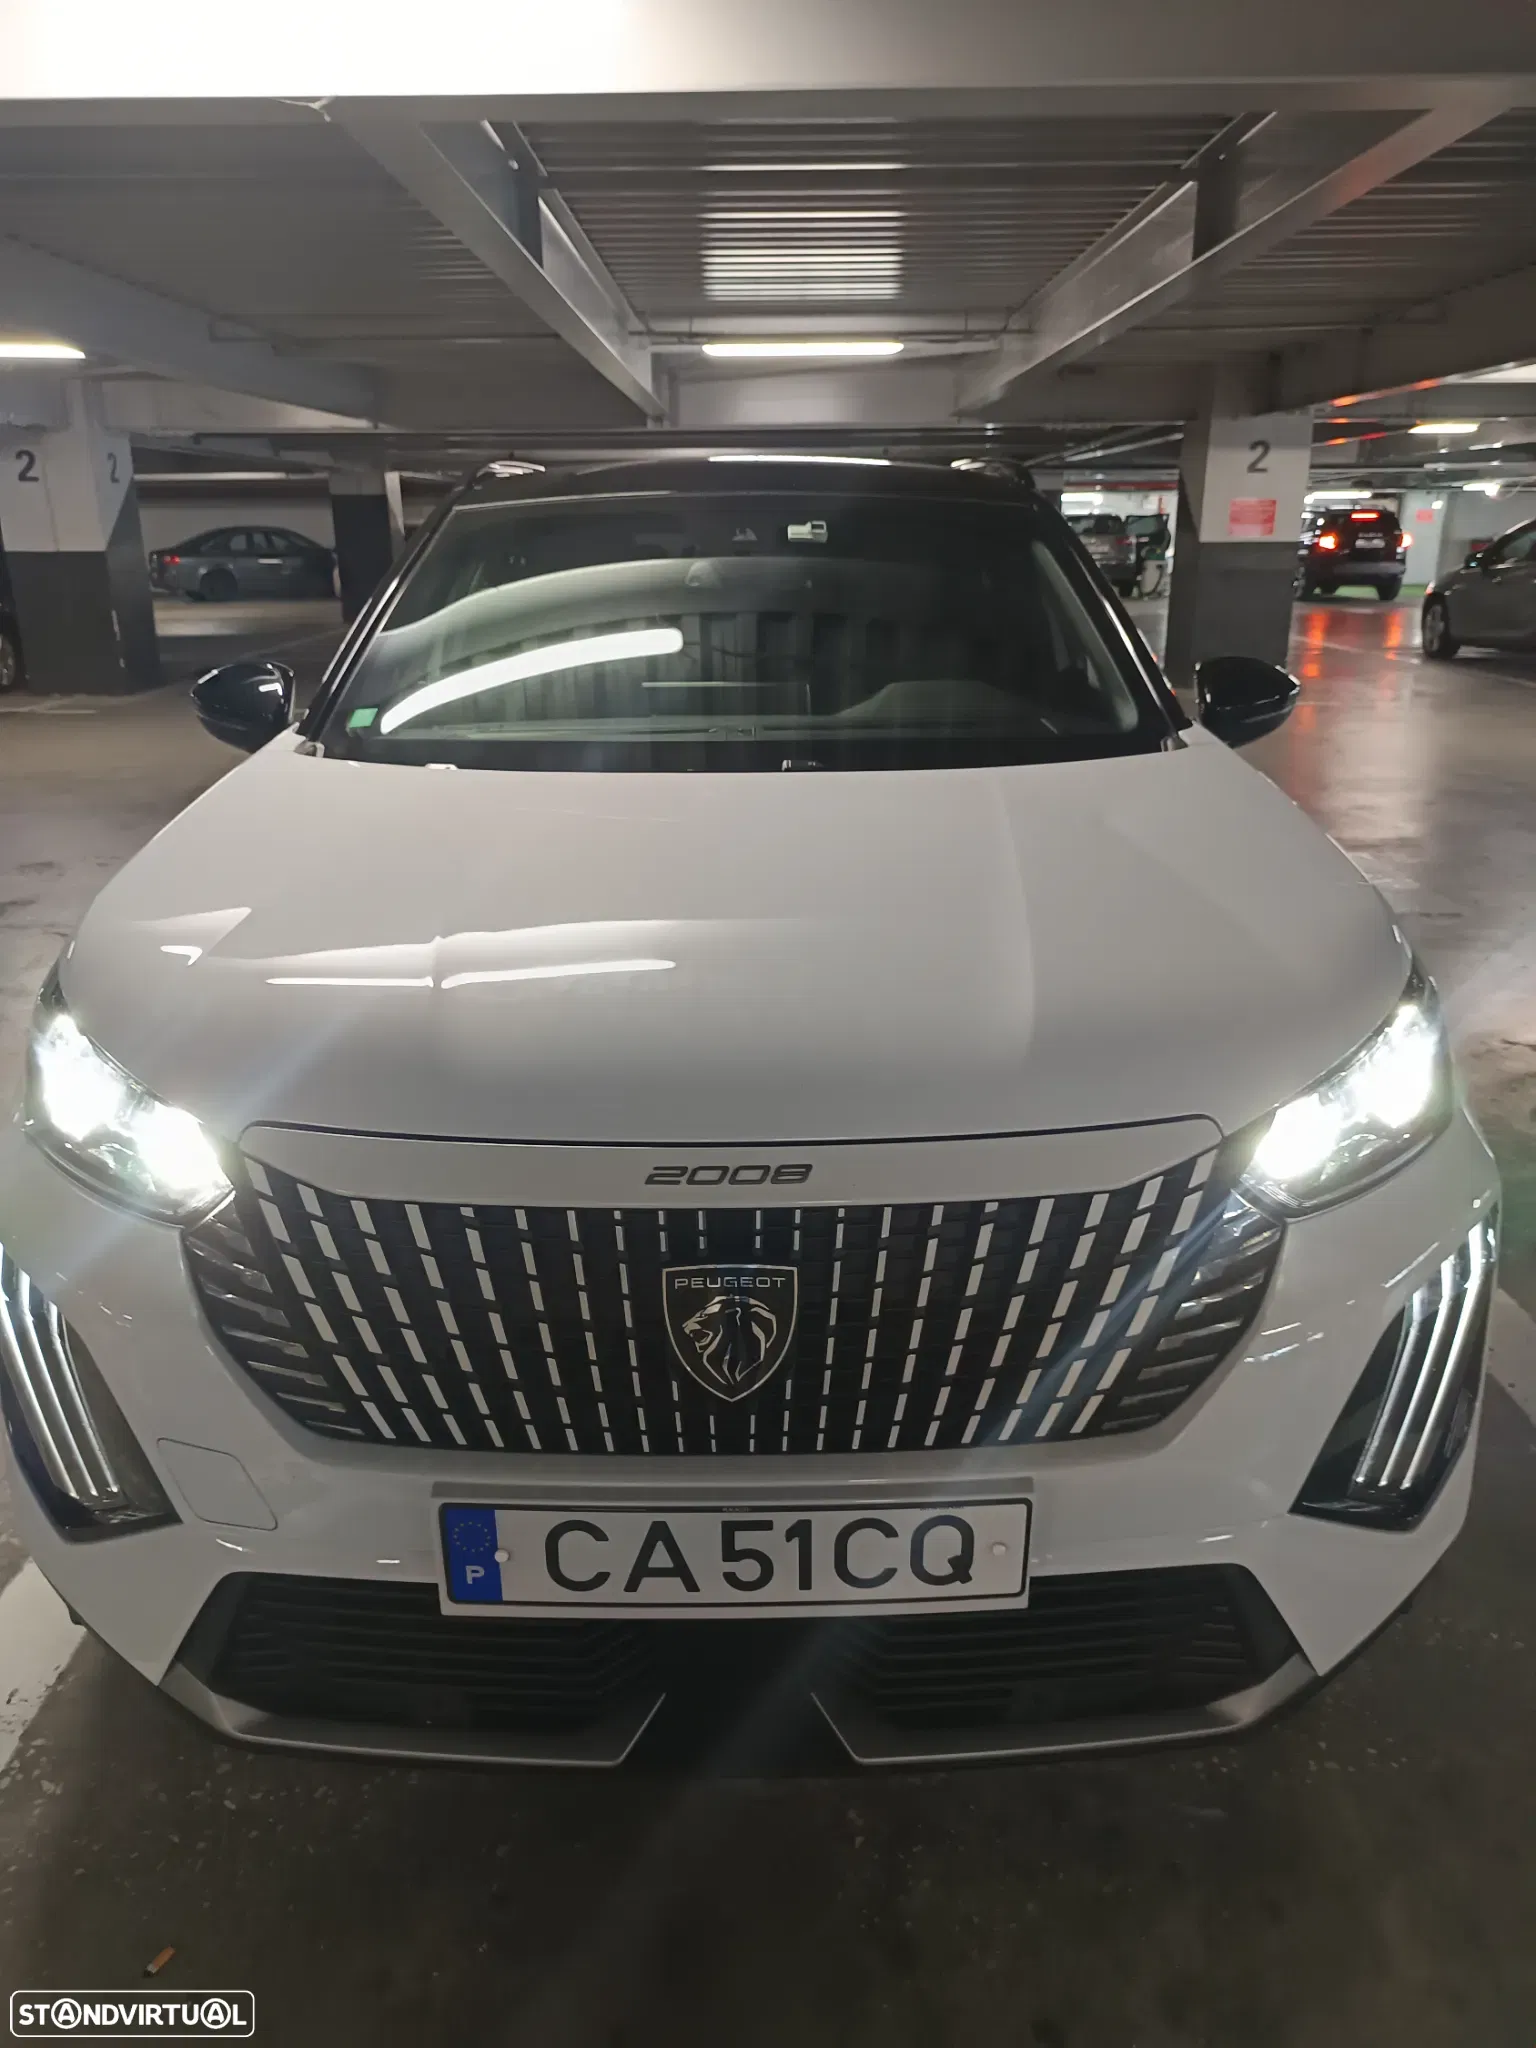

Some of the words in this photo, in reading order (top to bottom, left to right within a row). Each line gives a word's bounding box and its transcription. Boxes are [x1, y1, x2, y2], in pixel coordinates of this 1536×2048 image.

[15, 449, 40, 482] 2
[107, 452, 120, 483] 2
[1247, 439, 1271, 474] 2
[644, 1163, 813, 1186] 2008
[674, 1276, 786, 1290] PEUGEOT
[466, 1565, 485, 1585] P
